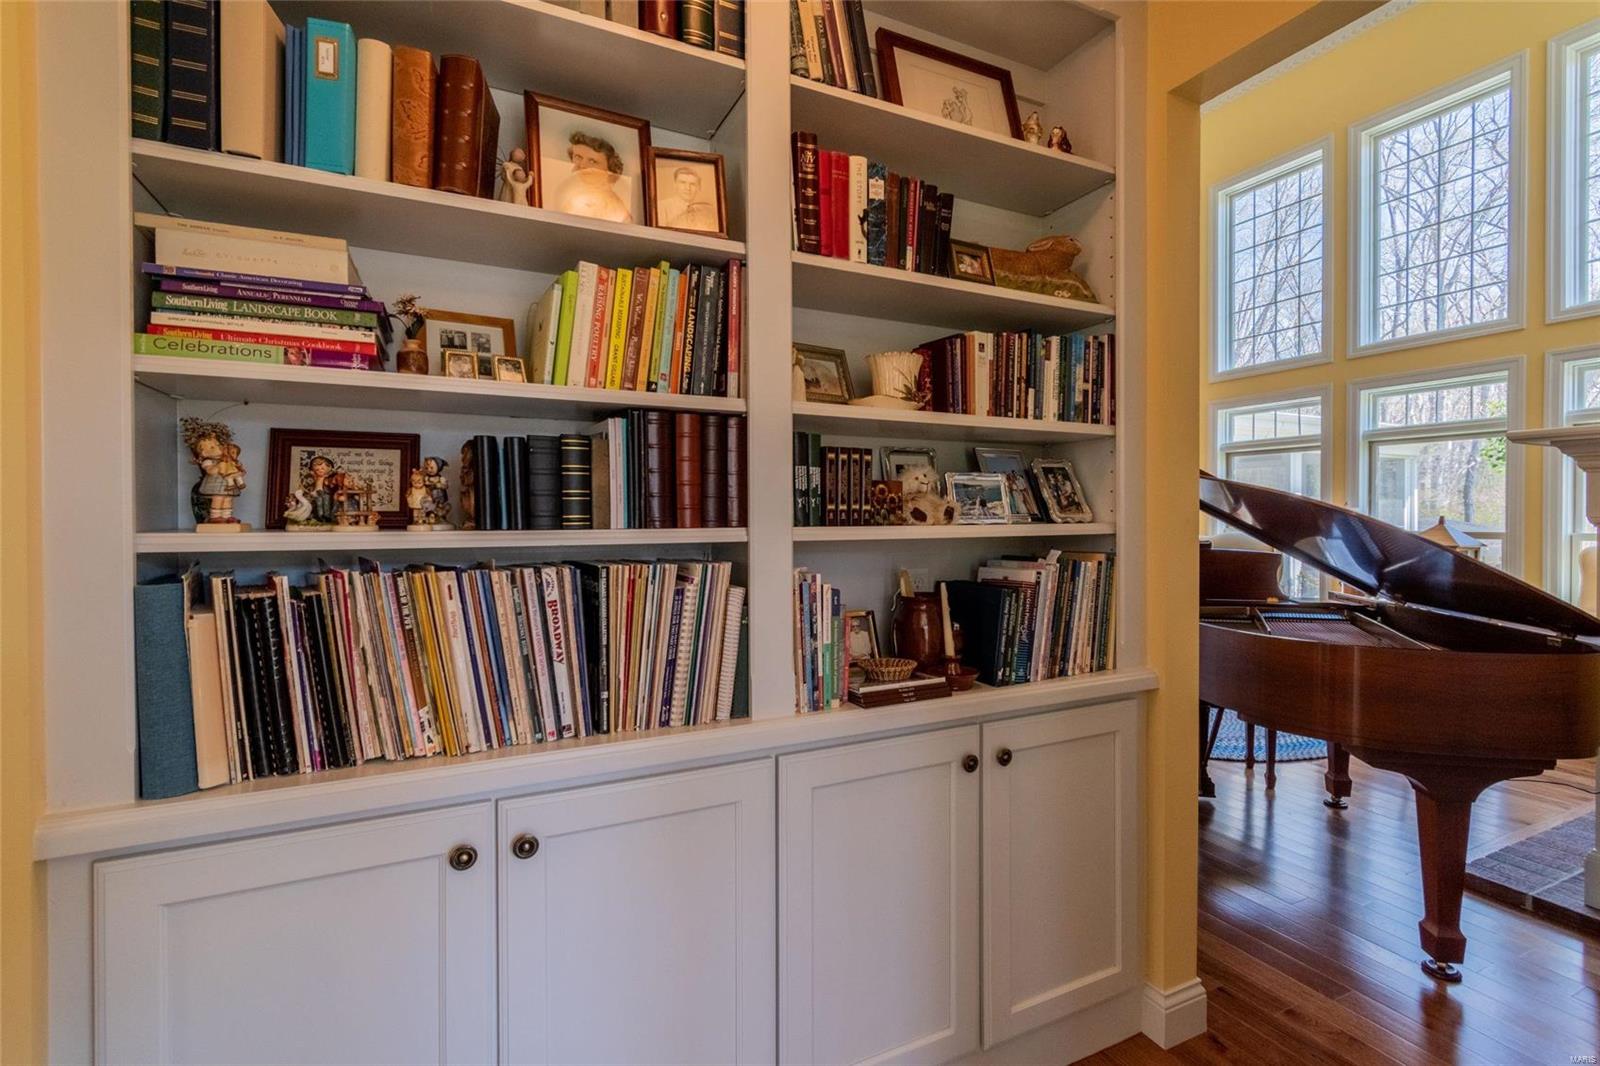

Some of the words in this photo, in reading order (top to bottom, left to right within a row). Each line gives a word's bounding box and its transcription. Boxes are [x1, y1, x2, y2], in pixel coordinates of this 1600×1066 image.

[165, 295, 203, 308] Southern
[203, 298, 228, 311] Living
[233, 301, 301, 317] LANDSCAPE
[304, 307, 337, 320] BOOK
[595, 284, 606, 320] RAISING
[152, 336, 272, 359] Celebrations
[259, 336, 299, 347] Christmas
[590, 321, 601, 362] POULTRY
[684, 308, 696, 373] LANDSCAPING
[612, 344, 620, 363] GRANT
[547, 599, 565, 665] BROADWAY
